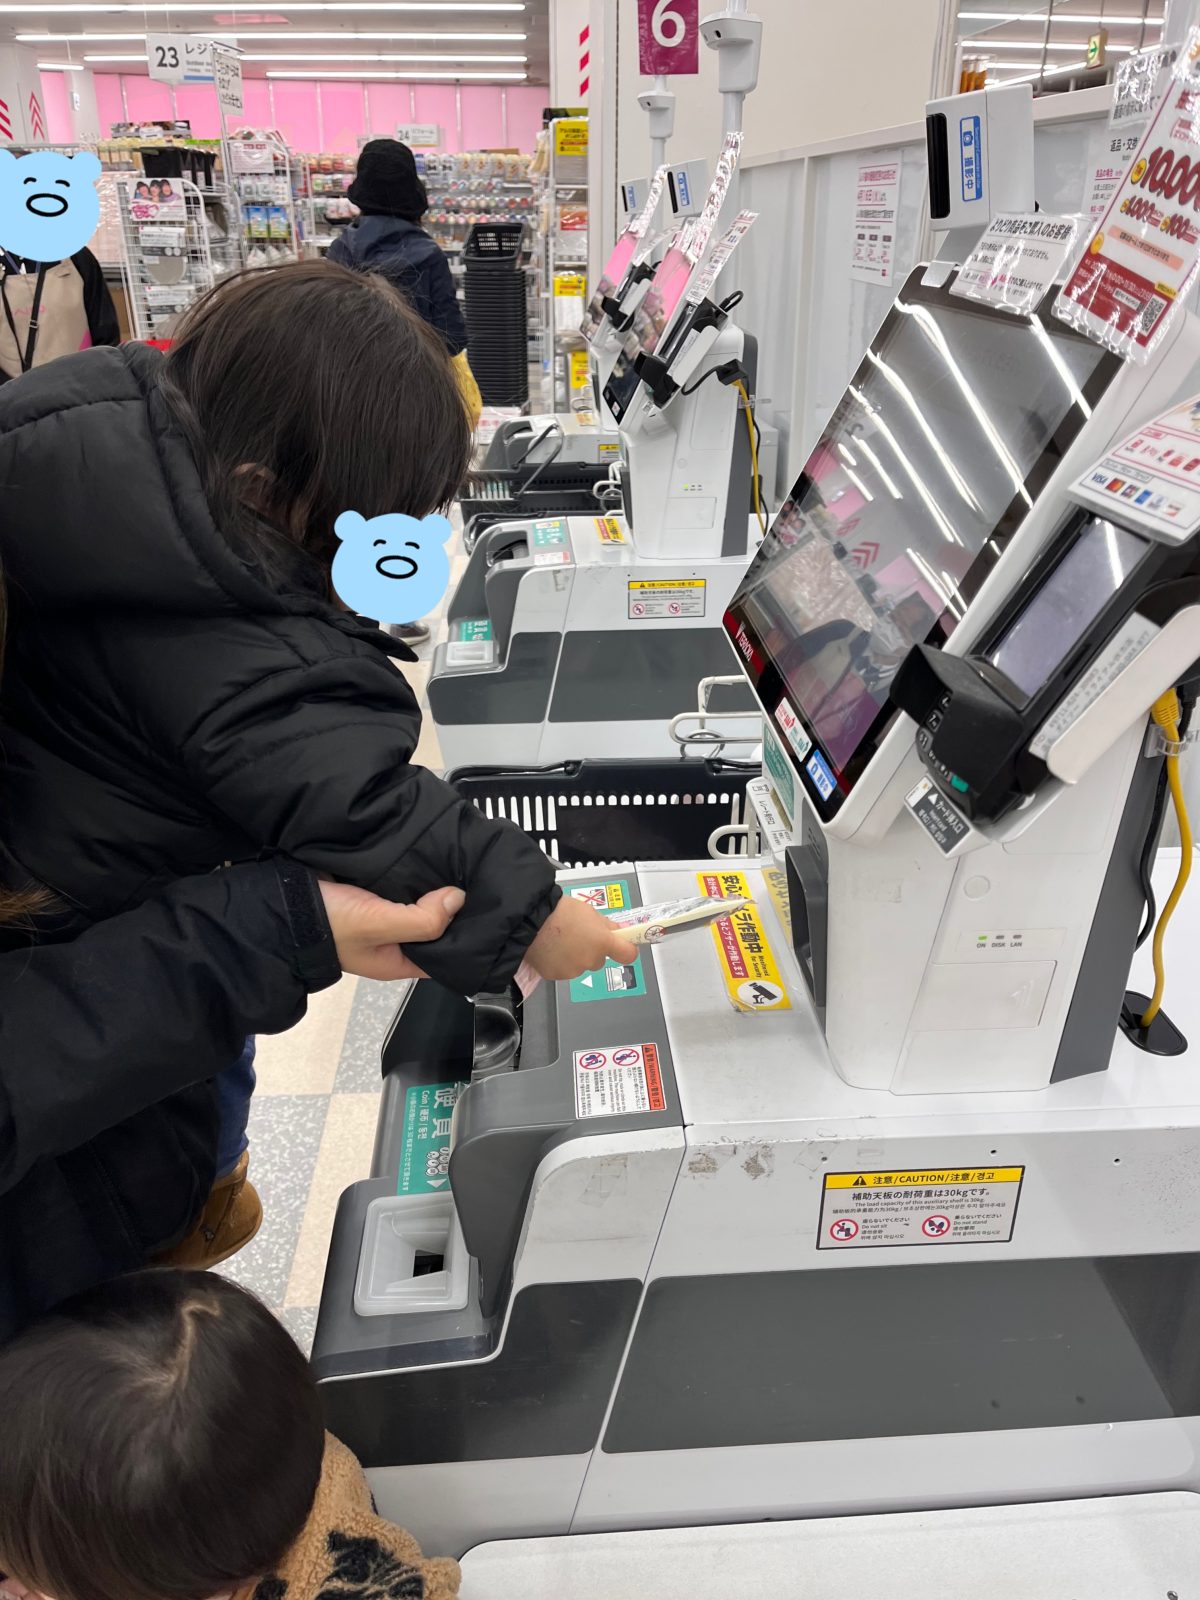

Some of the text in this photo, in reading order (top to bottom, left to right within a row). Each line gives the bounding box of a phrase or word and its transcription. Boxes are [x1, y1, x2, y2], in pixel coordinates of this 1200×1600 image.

[652, 0, 685, 47] 6
[155, 46, 179, 68] 23
[421, 1090, 430, 1105] Coin
[852, 1188, 990, 1201] 補助天板の耐荷重は30kgです。
